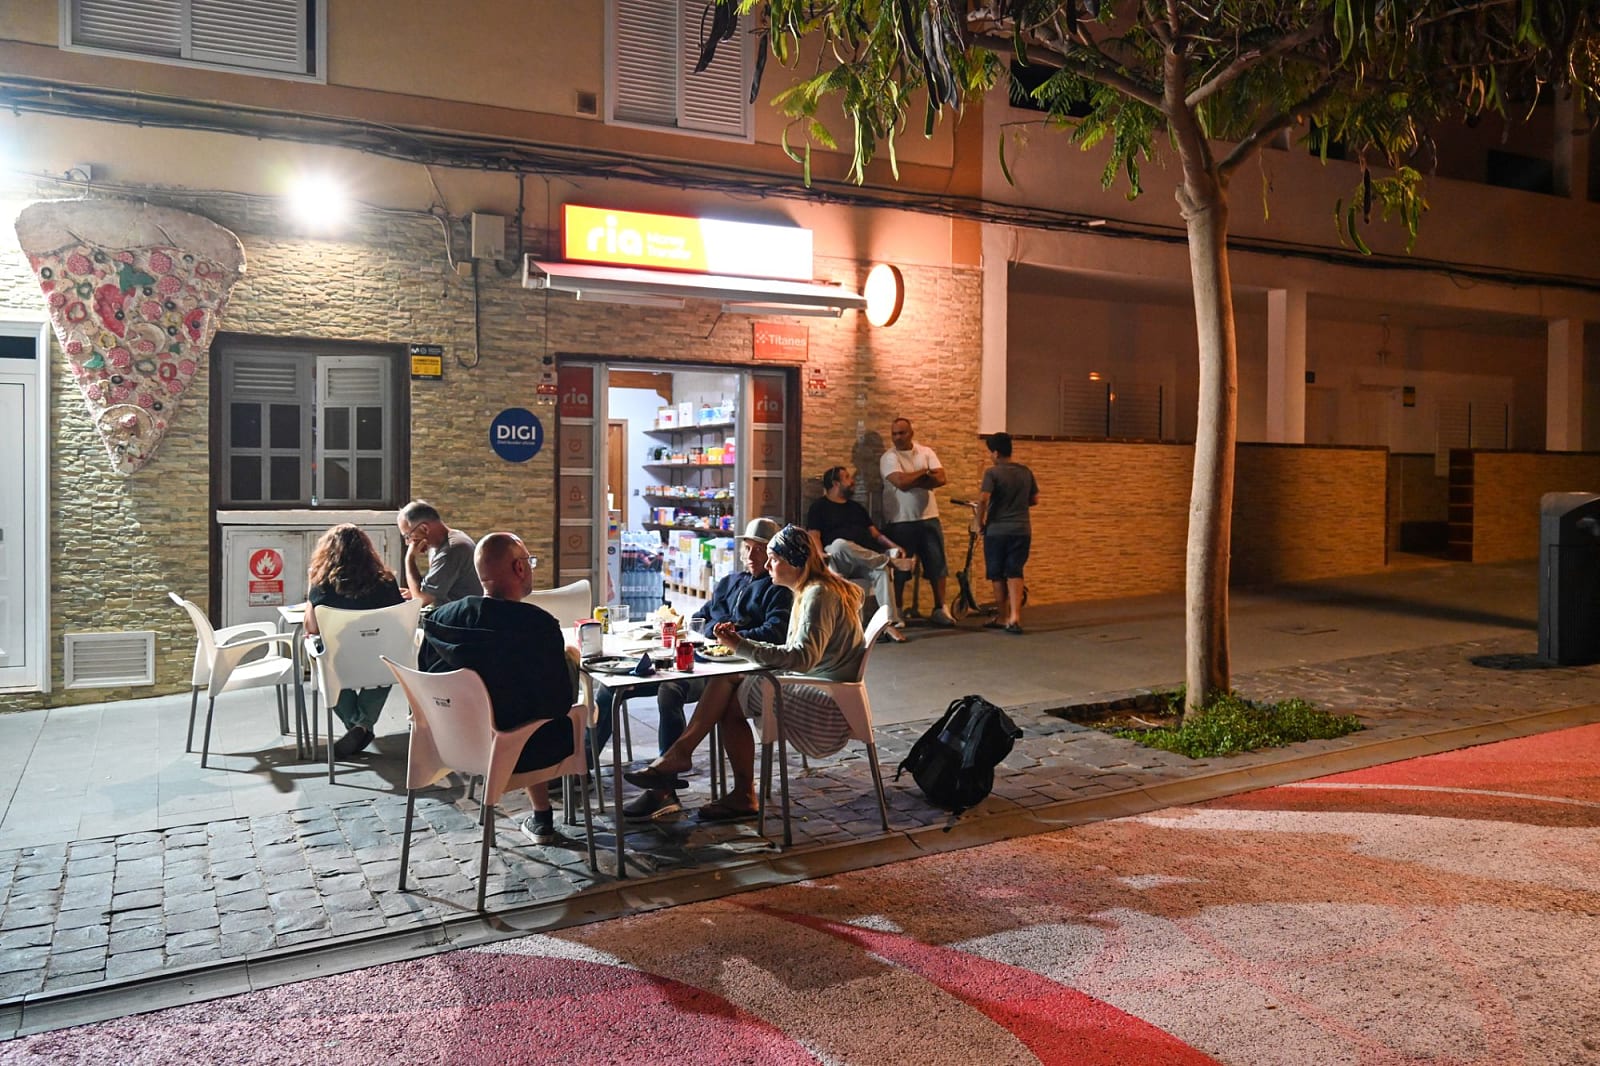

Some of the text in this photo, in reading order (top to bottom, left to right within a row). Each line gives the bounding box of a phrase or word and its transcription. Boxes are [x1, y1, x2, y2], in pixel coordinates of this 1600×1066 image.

[586, 214, 644, 256] ria
[563, 387, 589, 405] ria
[757, 395, 778, 411] ria
[497, 425, 536, 440] DIGI
